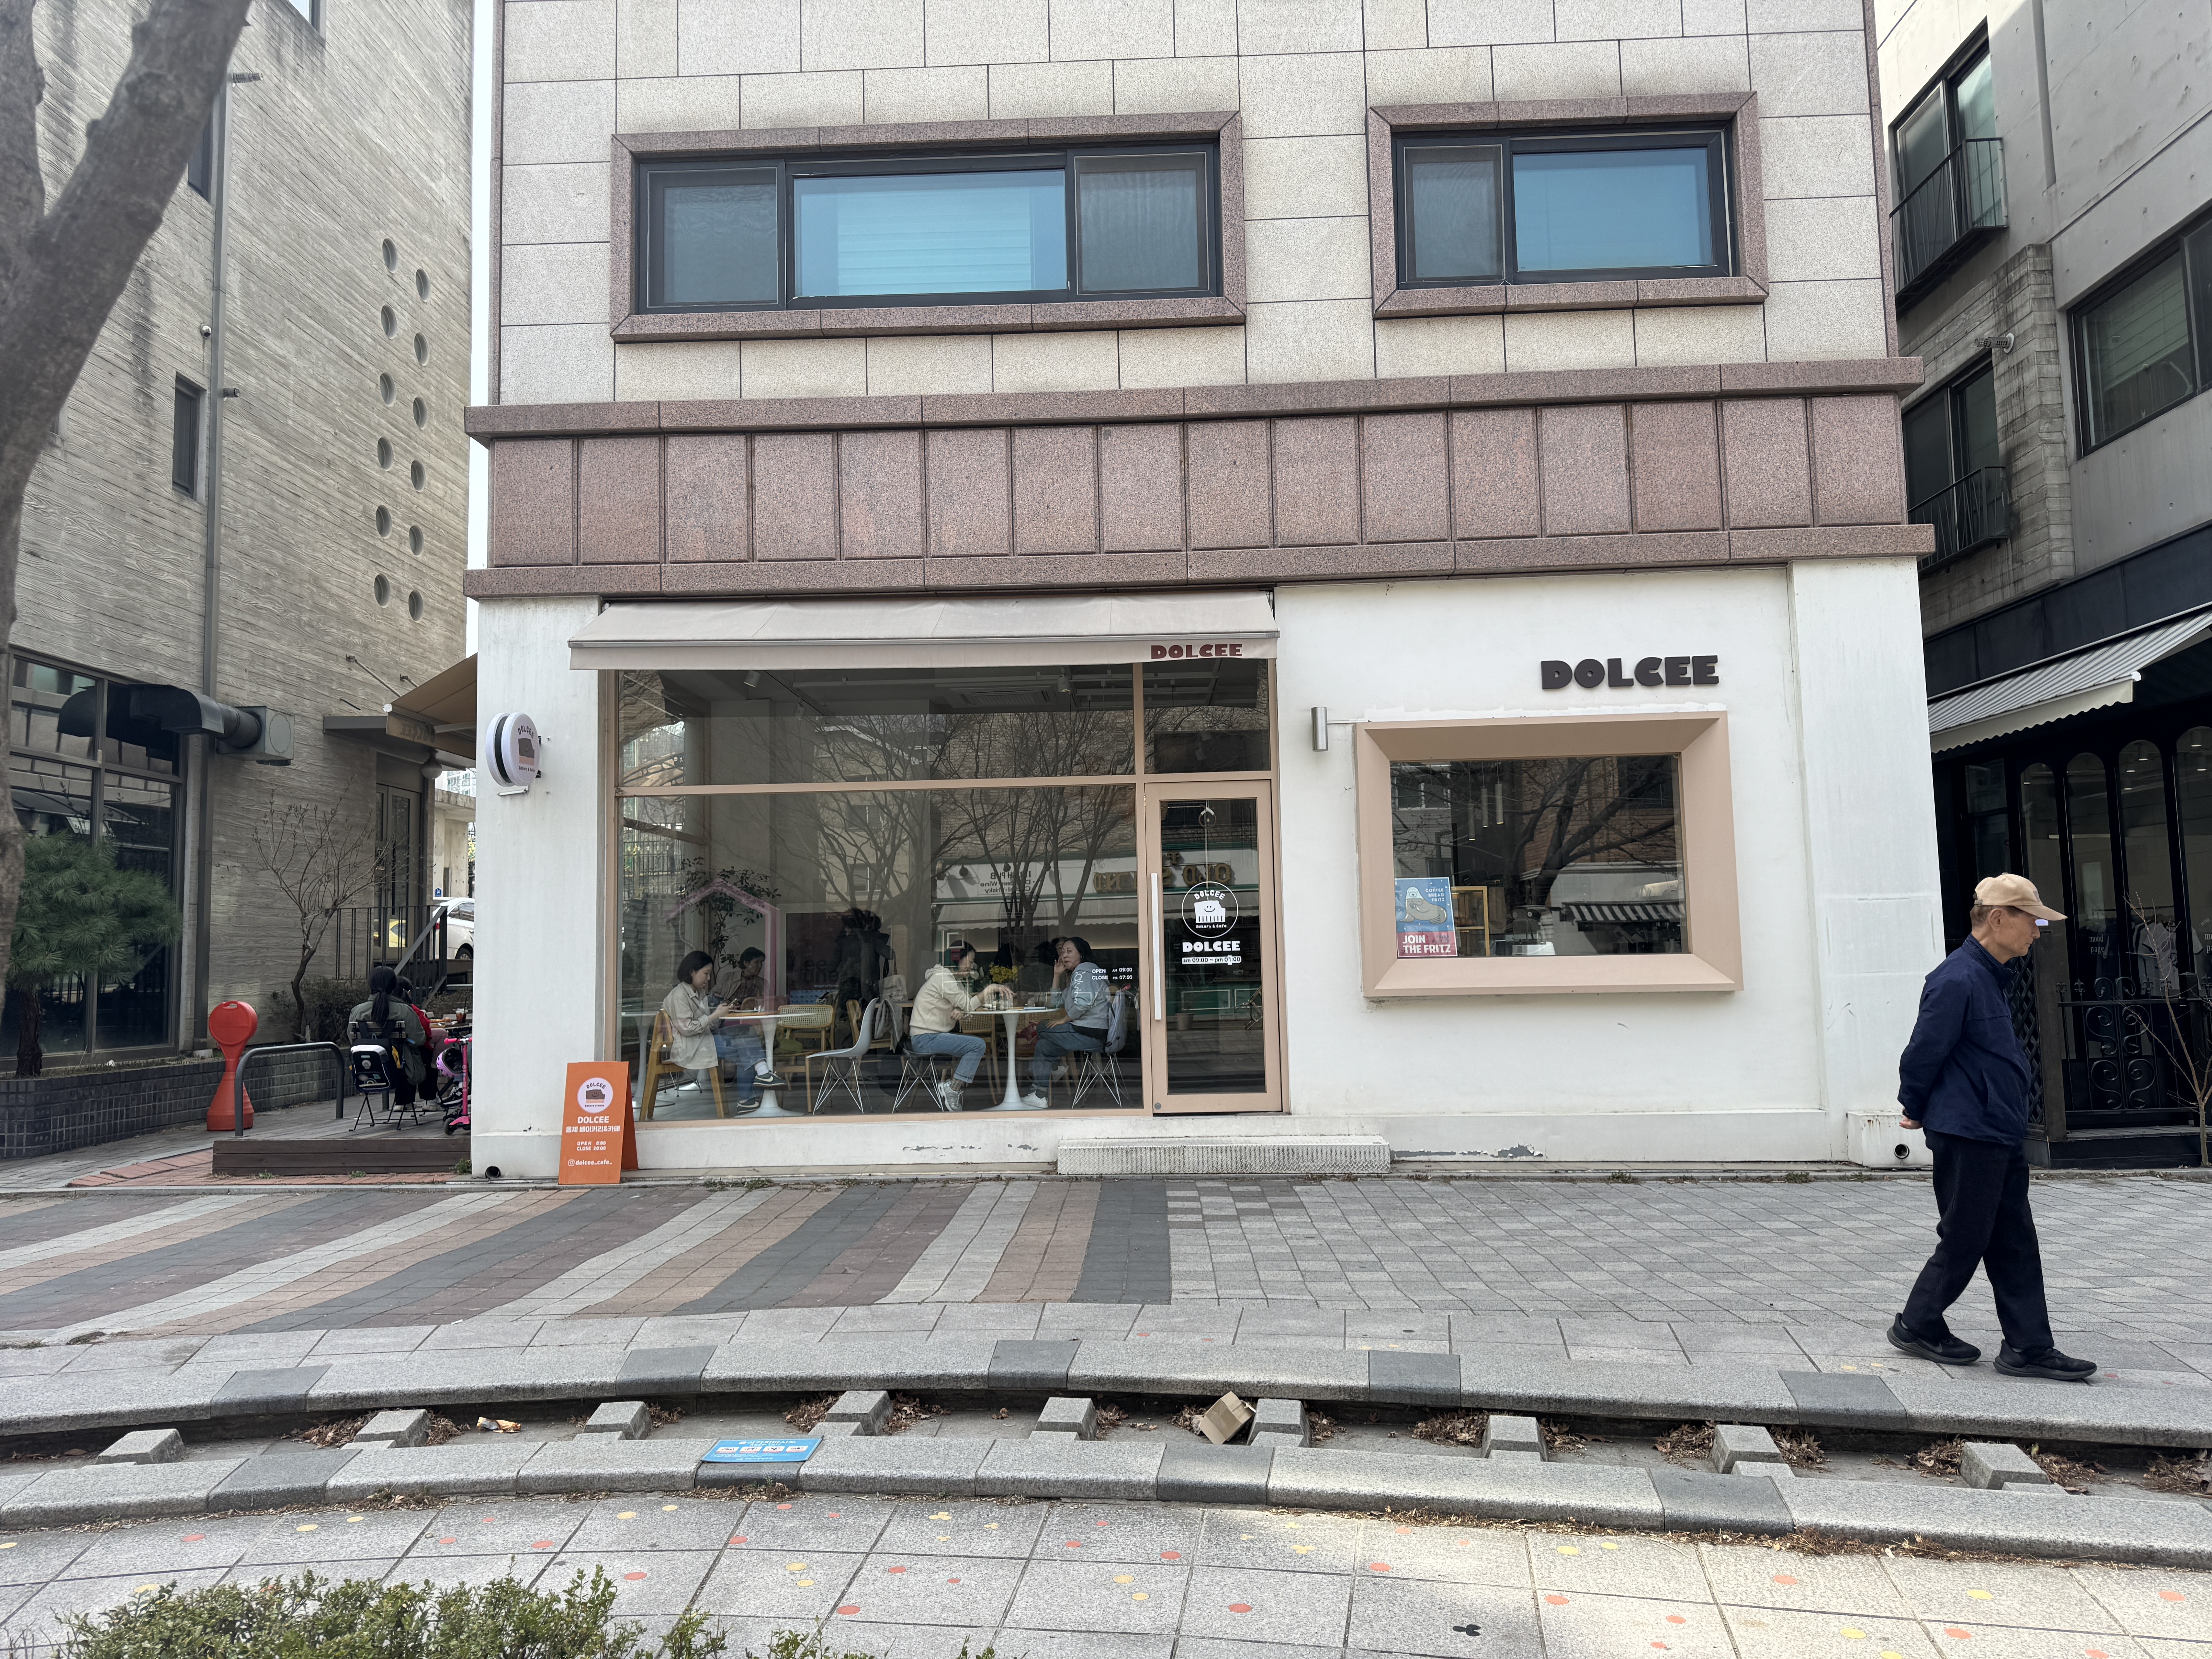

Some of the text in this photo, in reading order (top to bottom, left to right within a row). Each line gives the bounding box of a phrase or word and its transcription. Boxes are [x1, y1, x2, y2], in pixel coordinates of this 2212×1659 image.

[1151, 644, 1242, 659] DOLCEE
[1540, 655, 1719, 689] DOLCEE
[518, 725, 534, 739] DOLCEE
[1194, 890, 1225, 900] DOLCEE
[1402, 935, 1426, 944] JOIN
[2089, 934, 2104, 942] mood
[1182, 941, 1240, 952] DOLCEE
[1403, 944, 1451, 954] THE FRITZ
[577, 1116, 609, 1124] DOLCEE
